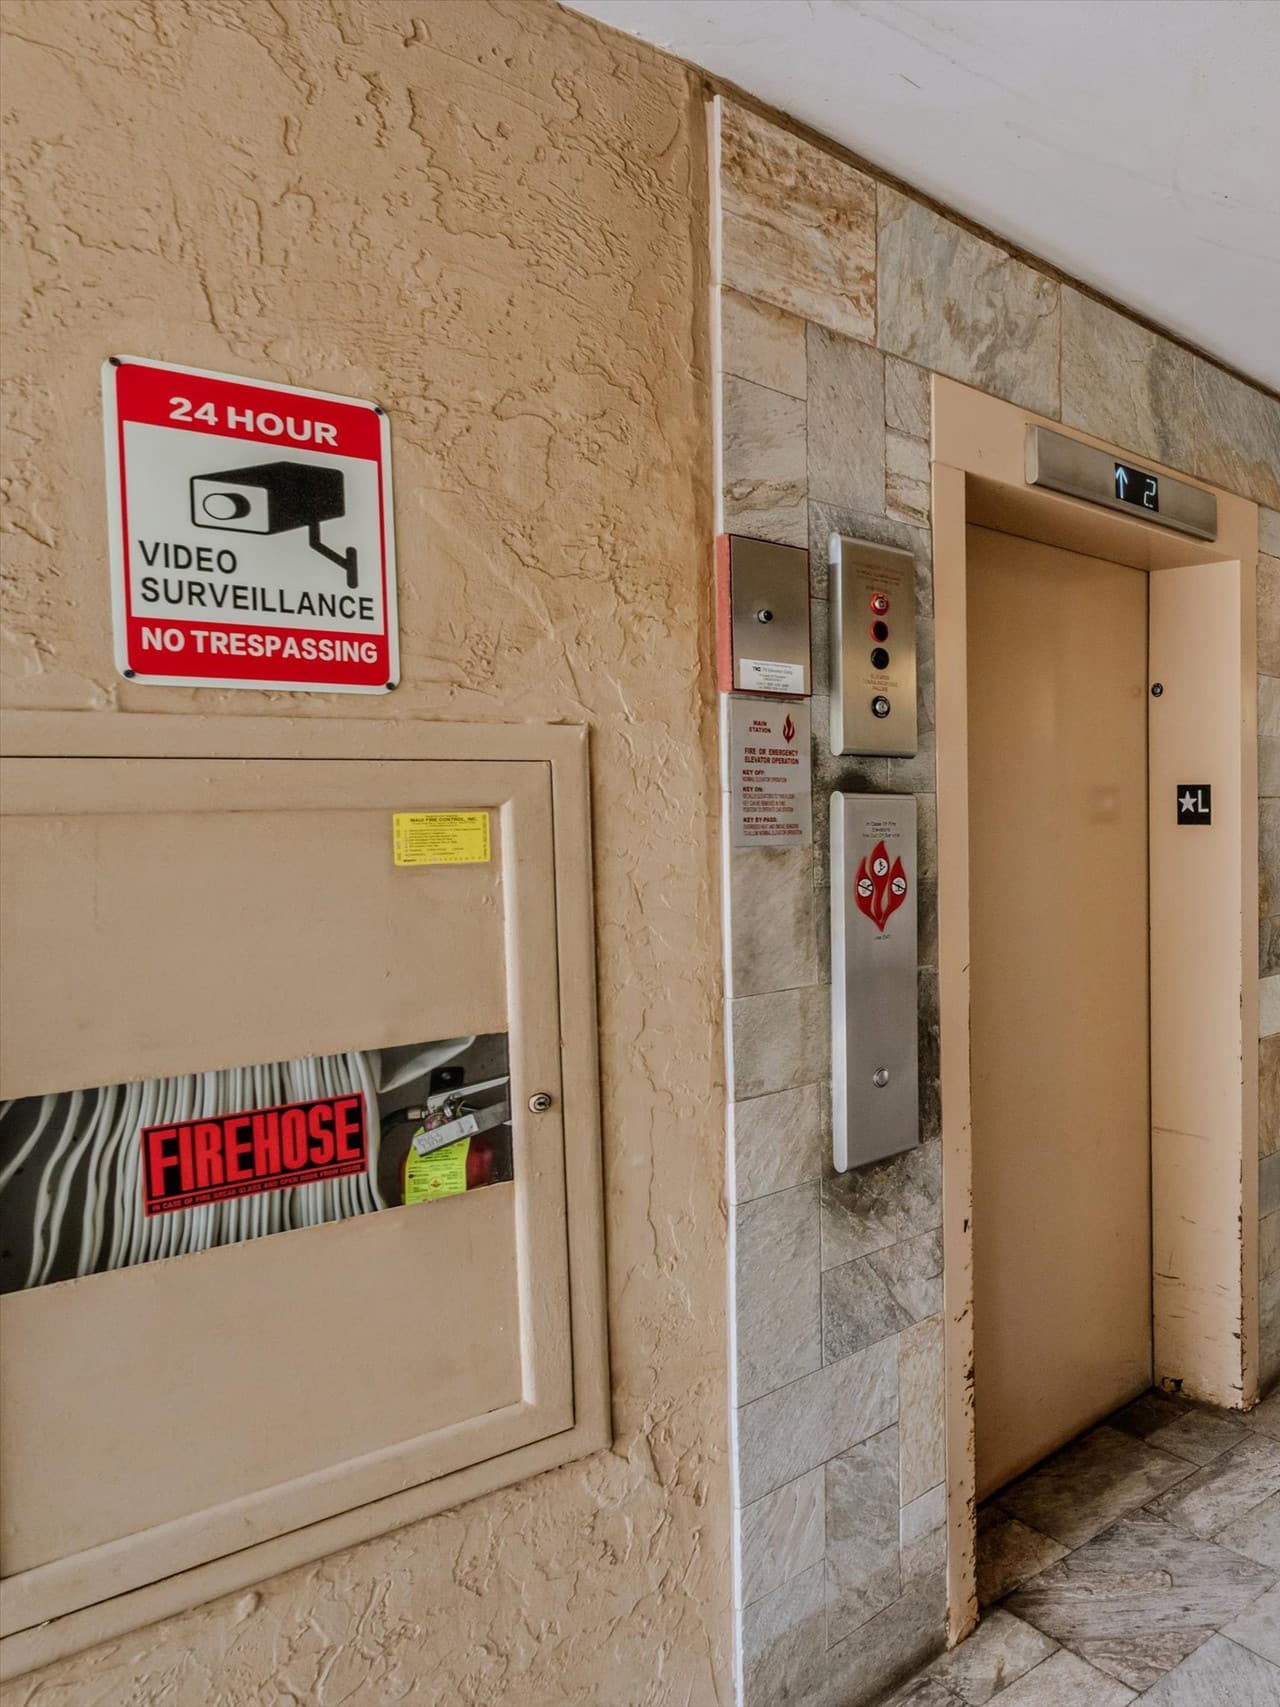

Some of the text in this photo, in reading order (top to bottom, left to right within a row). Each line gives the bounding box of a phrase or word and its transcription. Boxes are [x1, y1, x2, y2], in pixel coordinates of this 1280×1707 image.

[169, 397, 338, 447] 24 HOUR
[1143, 478, 1157, 508] 2
[138, 540, 237, 574] VIDEO
[141, 577, 375, 621] SURVEILLANCE
[141, 627, 378, 664] NO TRESPASSING
[749, 726, 772, 734] STATION
[744, 747, 756, 755] FIRE
[768, 748, 799, 757] EMERGENCY
[744, 756, 799, 765] ELEVATOR OPERATION
[1197, 789, 1210, 813] L
[149, 1099, 361, 1197] FIREHOSE
[162, 1200, 182, 1209] CASE
